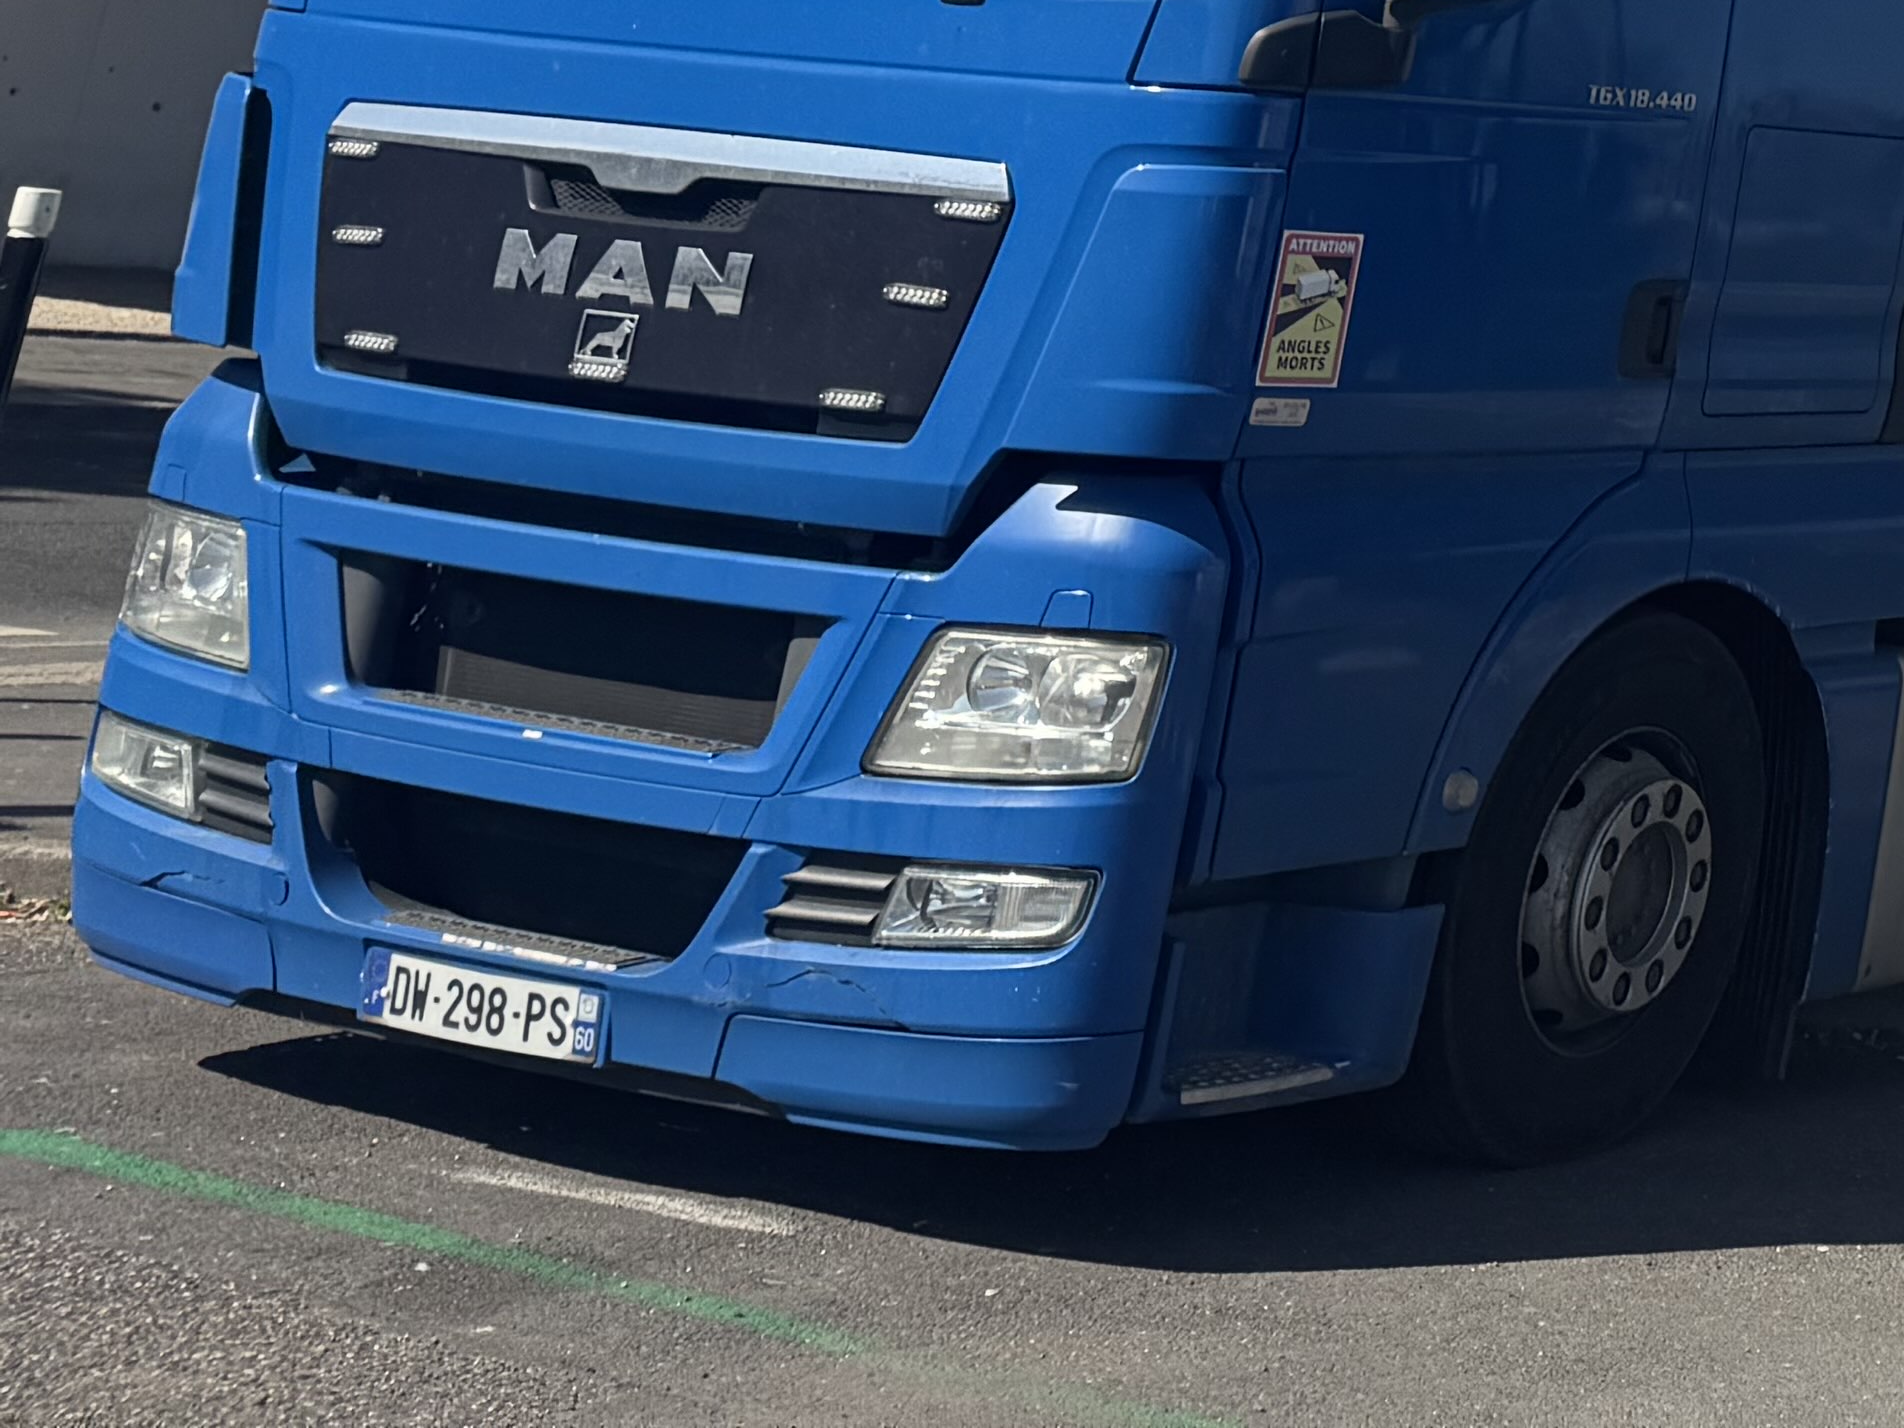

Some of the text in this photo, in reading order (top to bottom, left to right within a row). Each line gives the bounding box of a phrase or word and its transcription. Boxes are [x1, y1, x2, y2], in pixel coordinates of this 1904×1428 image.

[1588, 84, 1697, 112] TGX 18.440
[1288, 238, 1356, 255] ATTENTION
[492, 227, 754, 317] MAN
[1276, 339, 1331, 355] ANGLES
[1276, 356, 1326, 371] MORTS
[389, 966, 570, 1047] DW-298-PS
[574, 1028, 595, 1052] 60
